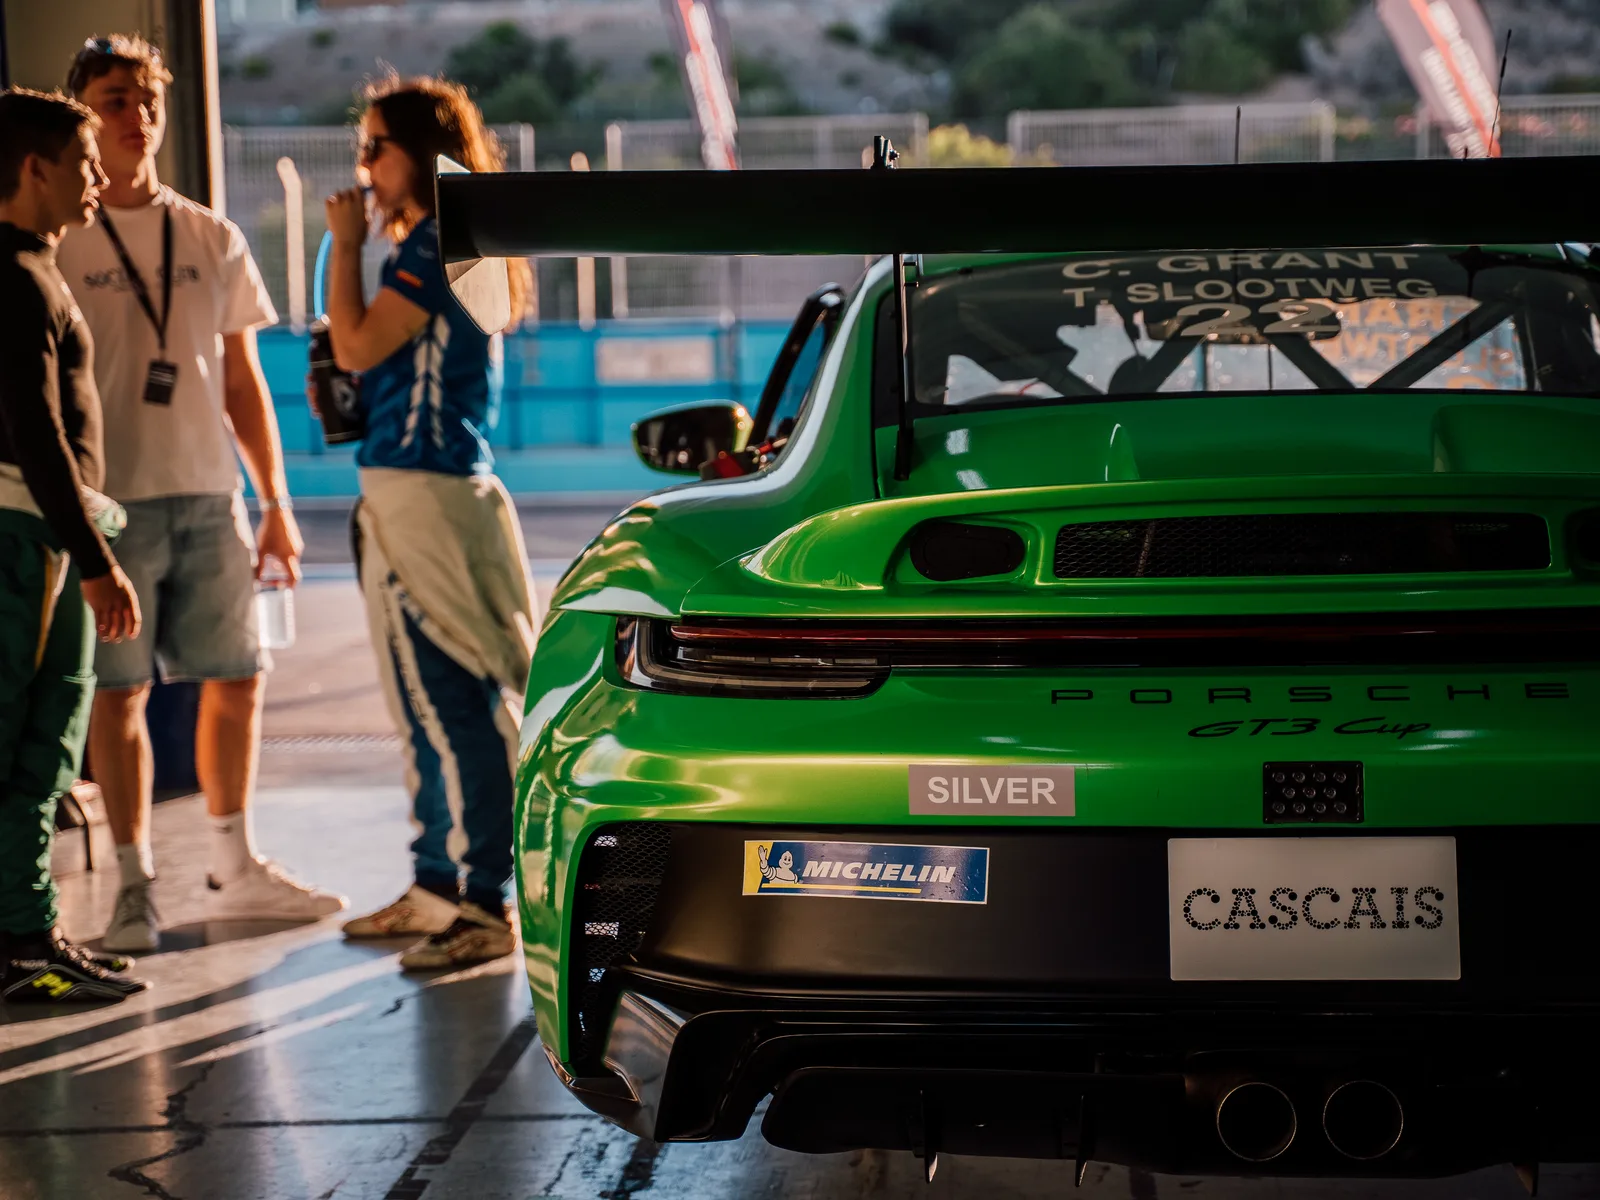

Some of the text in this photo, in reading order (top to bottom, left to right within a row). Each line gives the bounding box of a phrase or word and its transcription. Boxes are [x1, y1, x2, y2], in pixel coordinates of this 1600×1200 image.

[1062, 250, 1420, 280] C. GRANT
[1063, 277, 1438, 308] T. SLOOTWEG
[1177, 302, 1340, 336] 22
[1050, 681, 1570, 705] PORSCHE
[1187, 716, 1431, 740] GT3 Cup
[927, 776, 1057, 805] SILVER
[802, 860, 956, 883] MICHELIN
[1183, 886, 1444, 931] CASCAIS
